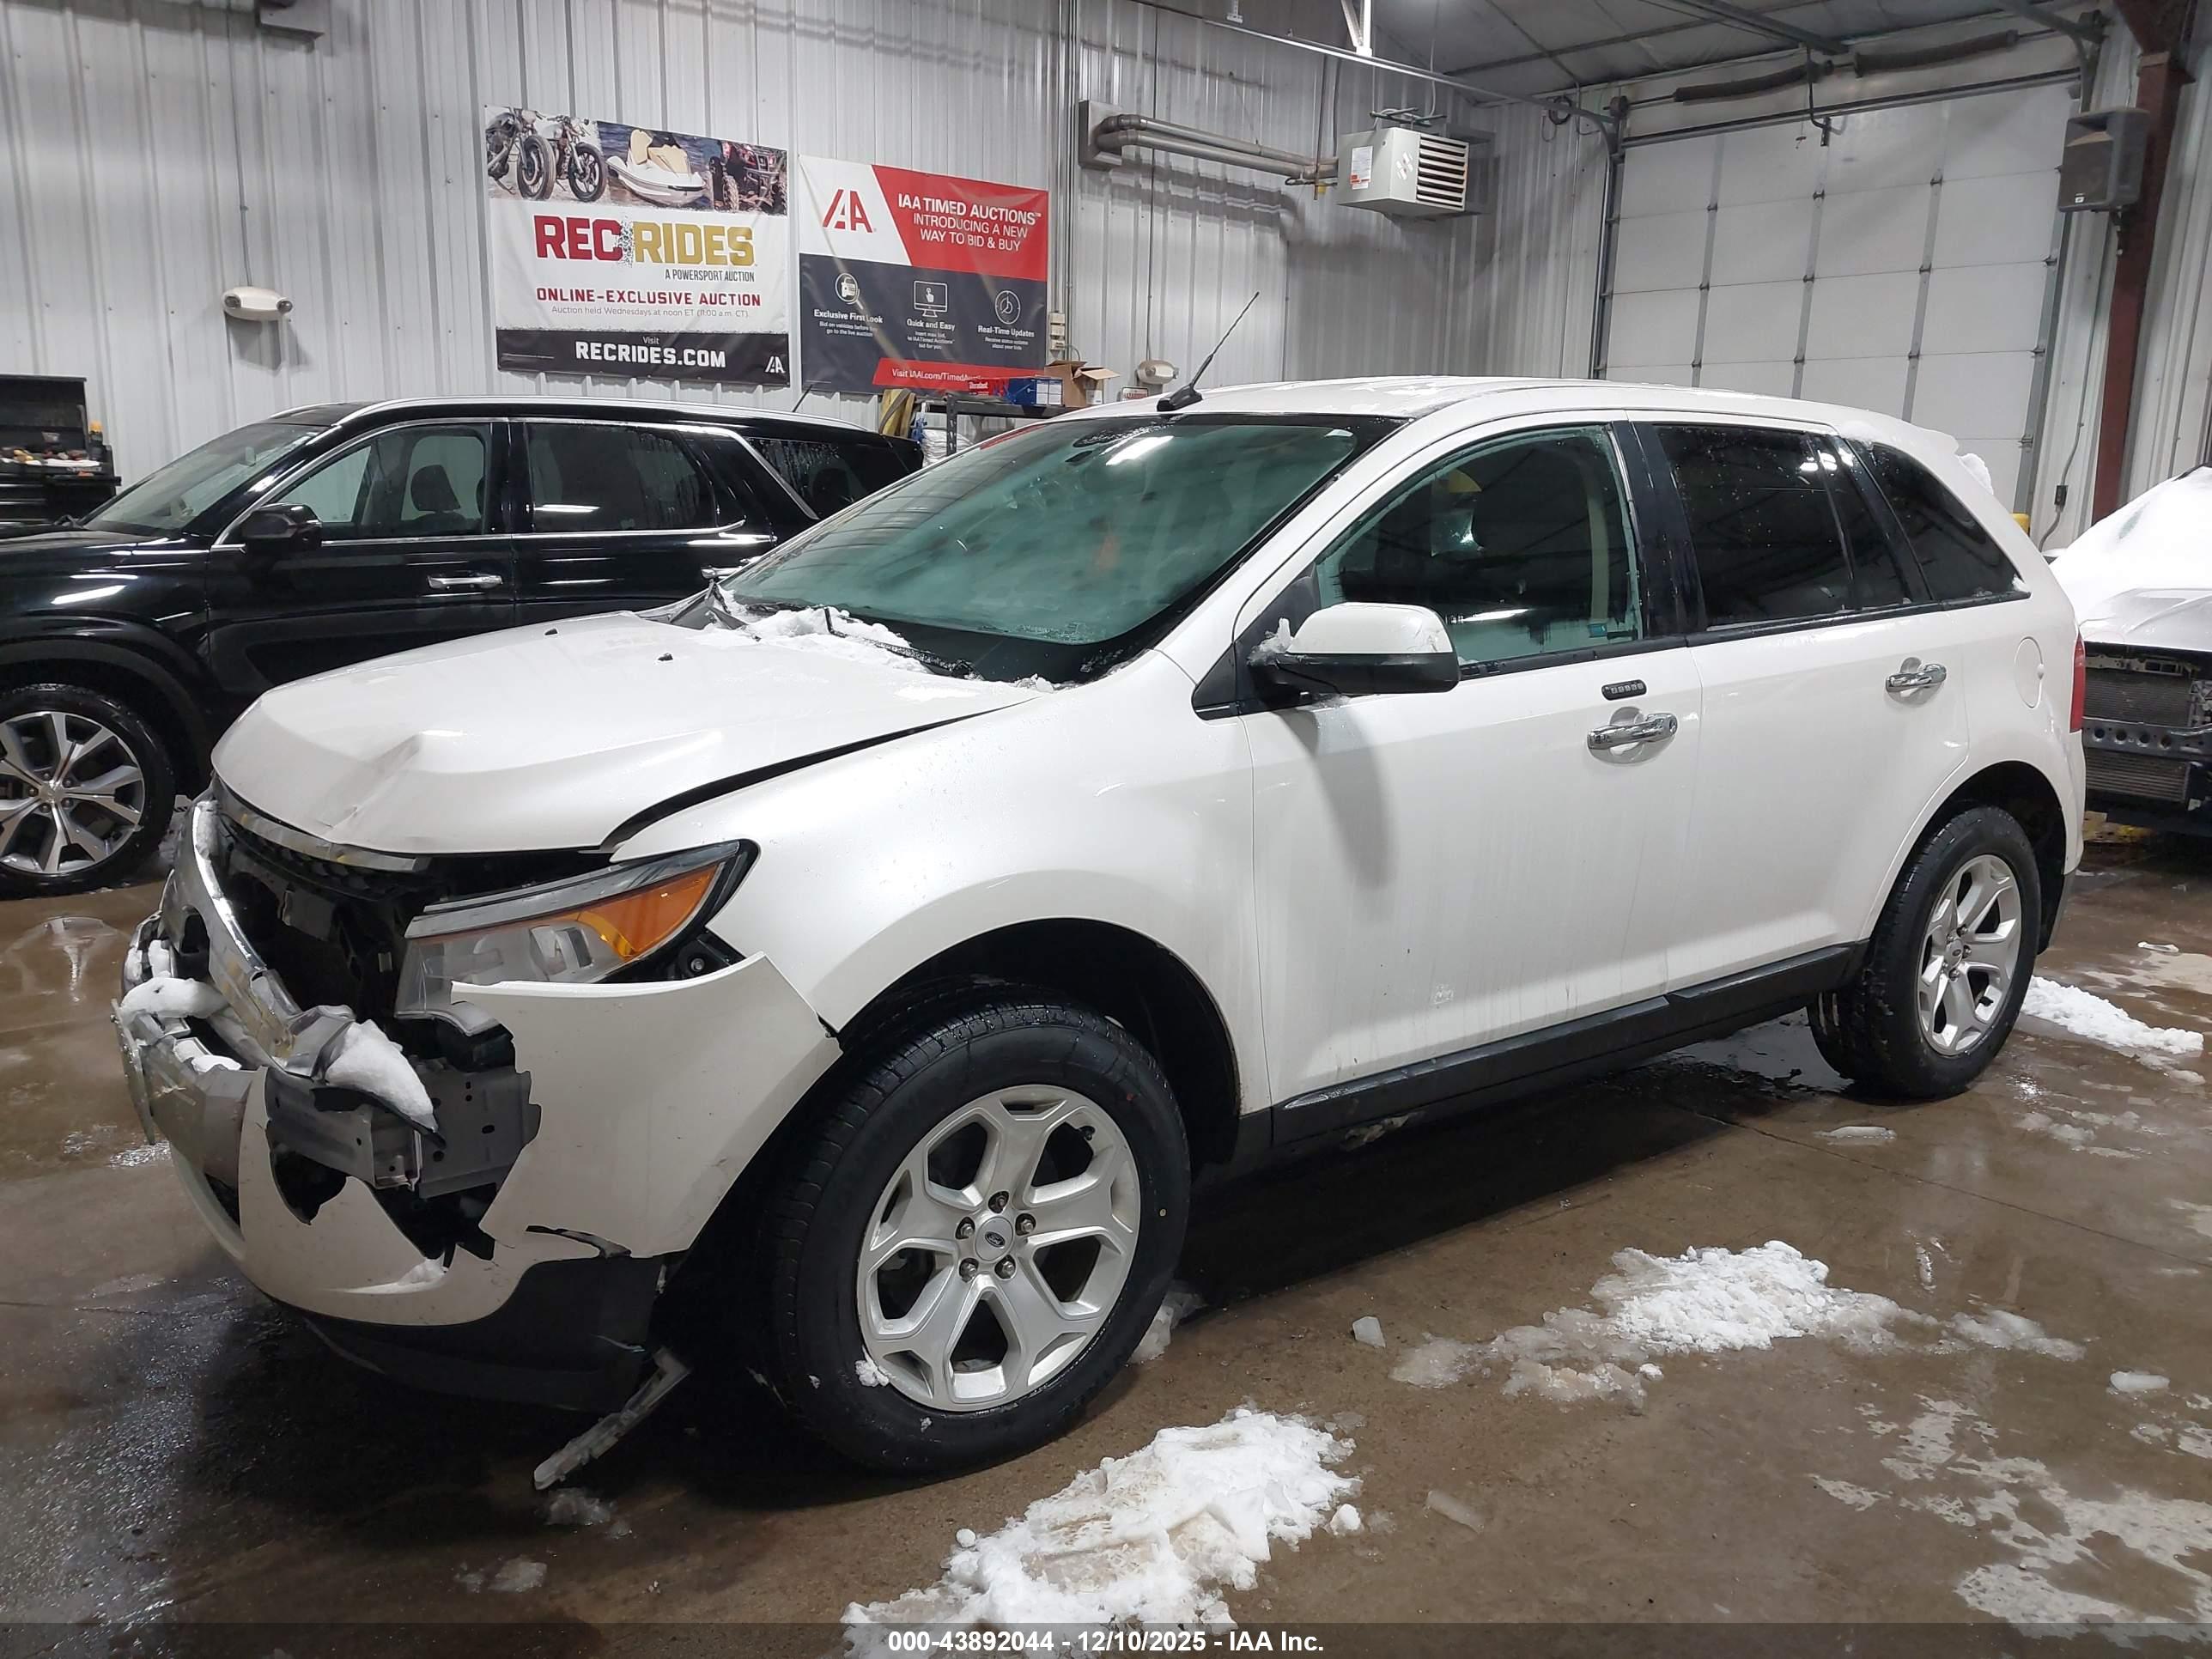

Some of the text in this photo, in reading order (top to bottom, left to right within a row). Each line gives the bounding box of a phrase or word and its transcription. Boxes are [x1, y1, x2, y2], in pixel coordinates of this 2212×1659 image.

[898, 193, 921, 210] IAA
[923, 197, 967, 216] TIMED
[913, 213, 1029, 239] INTRODUCING A NEW
[534, 215, 757, 267] REC RIDES
[920, 228, 1022, 252] WAY TO BID & BUY
[665, 270, 755, 283] A POWERSPORT AUCTION
[537, 288, 761, 307] ONLINE-EXCLUSIVE AUCTION
[551, 306, 583, 314] Auction
[604, 307, 652, 317] Wednesdays
[684, 308, 696, 317] ET
[813, 308, 884, 324] Exclusive First Look
[906, 318, 925, 328] Quick
[939, 321, 956, 332] Easy
[977, 325, 1035, 337] Real-Time Updates
[642, 336, 659, 345] Visit
[575, 341, 726, 368] RECRIDES.COM
[892, 368, 908, 378] Visit
